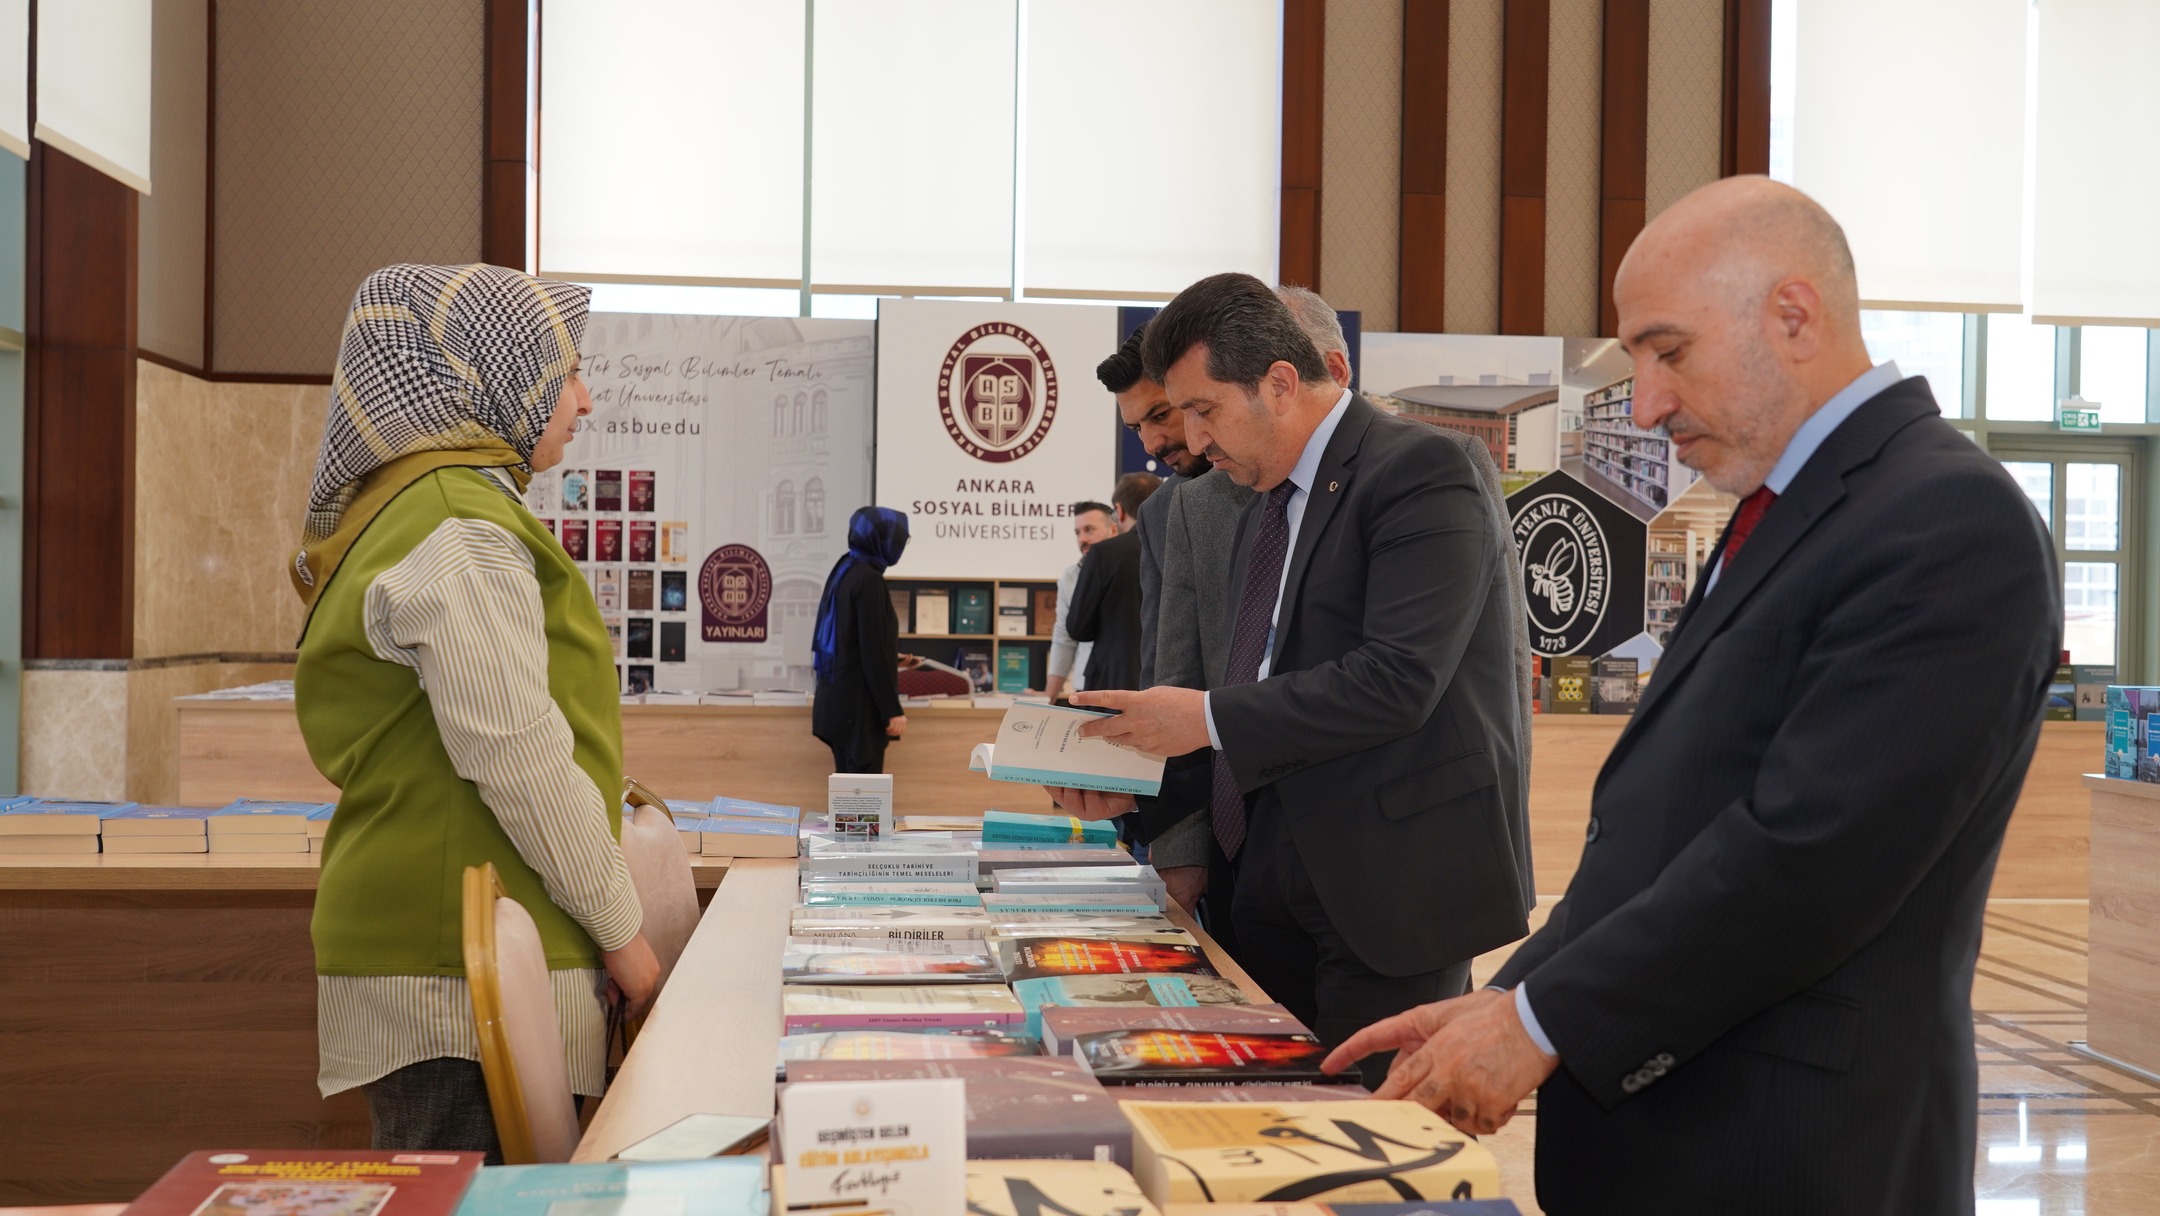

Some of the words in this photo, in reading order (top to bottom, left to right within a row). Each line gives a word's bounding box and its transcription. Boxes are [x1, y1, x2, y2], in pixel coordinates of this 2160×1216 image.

[969, 323, 1042, 354] BİLİMLER
[582, 354, 611, 376] Tek
[618, 354, 673, 382] Sosyal
[939, 342, 966, 398] SOSYAL
[607, 418, 701, 435] asbuedu
[941, 407, 985, 458] ANKARA
[956, 478, 1036, 494] ANKARA
[912, 500, 984, 516] SOSYAL
[991, 499, 1076, 518] BİLİMLER
[935, 521, 1055, 540] ÜNİVERSİTESİ
[1515, 500, 1572, 537] TEKNİK
[1572, 511, 1605, 616] ÜNİVERSİTESİ
[705, 626, 765, 639] YAYINLARI
[1538, 635, 1568, 652] 1773
[839, 870, 889, 878] TARİHÇİLİĞİNİN
[868, 863, 900, 871] SELÇUKLU
[902, 862, 925, 870] TARİHİ
[888, 929, 944, 941] BİLDİRİLER
